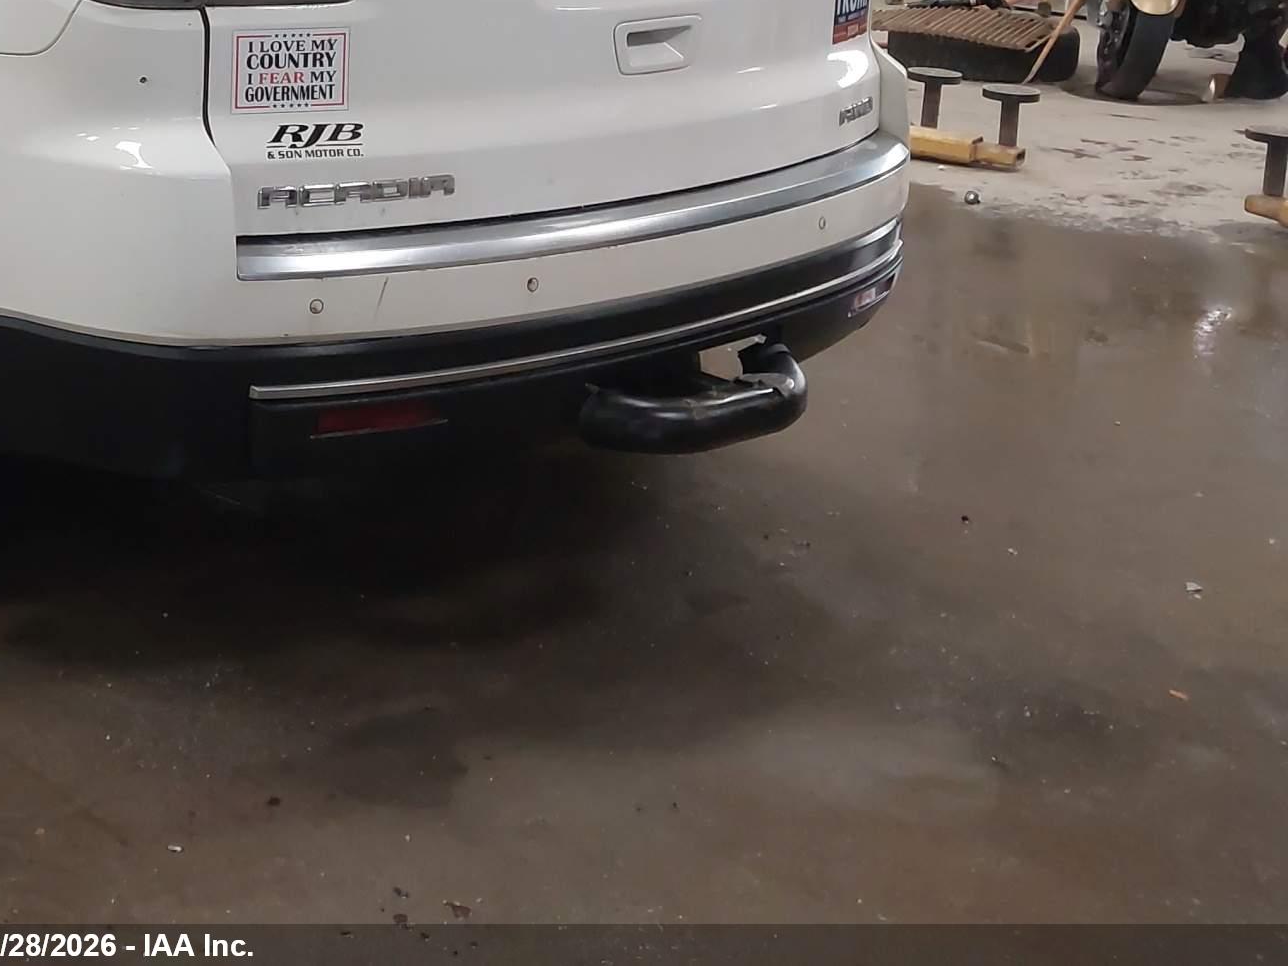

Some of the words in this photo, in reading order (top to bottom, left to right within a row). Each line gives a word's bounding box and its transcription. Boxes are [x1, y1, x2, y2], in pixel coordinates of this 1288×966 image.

[248, 41, 253, 53] I
[260, 40, 306, 52] LOVE
[311, 39, 337, 51] MY
[246, 52, 337, 70] COUNTRY
[248, 73, 253, 85] I
[259, 72, 305, 85] FEAR
[310, 71, 336, 83] MY
[245, 84, 335, 102] GOVERNMENT
[266, 123, 364, 149] RJB
[267, 151, 275, 160] &
[278, 150, 302, 159] SON
[305, 149, 344, 158] MOTOR
[347, 148, 364, 157] CO.
[257, 175, 455, 209] ACADIA
